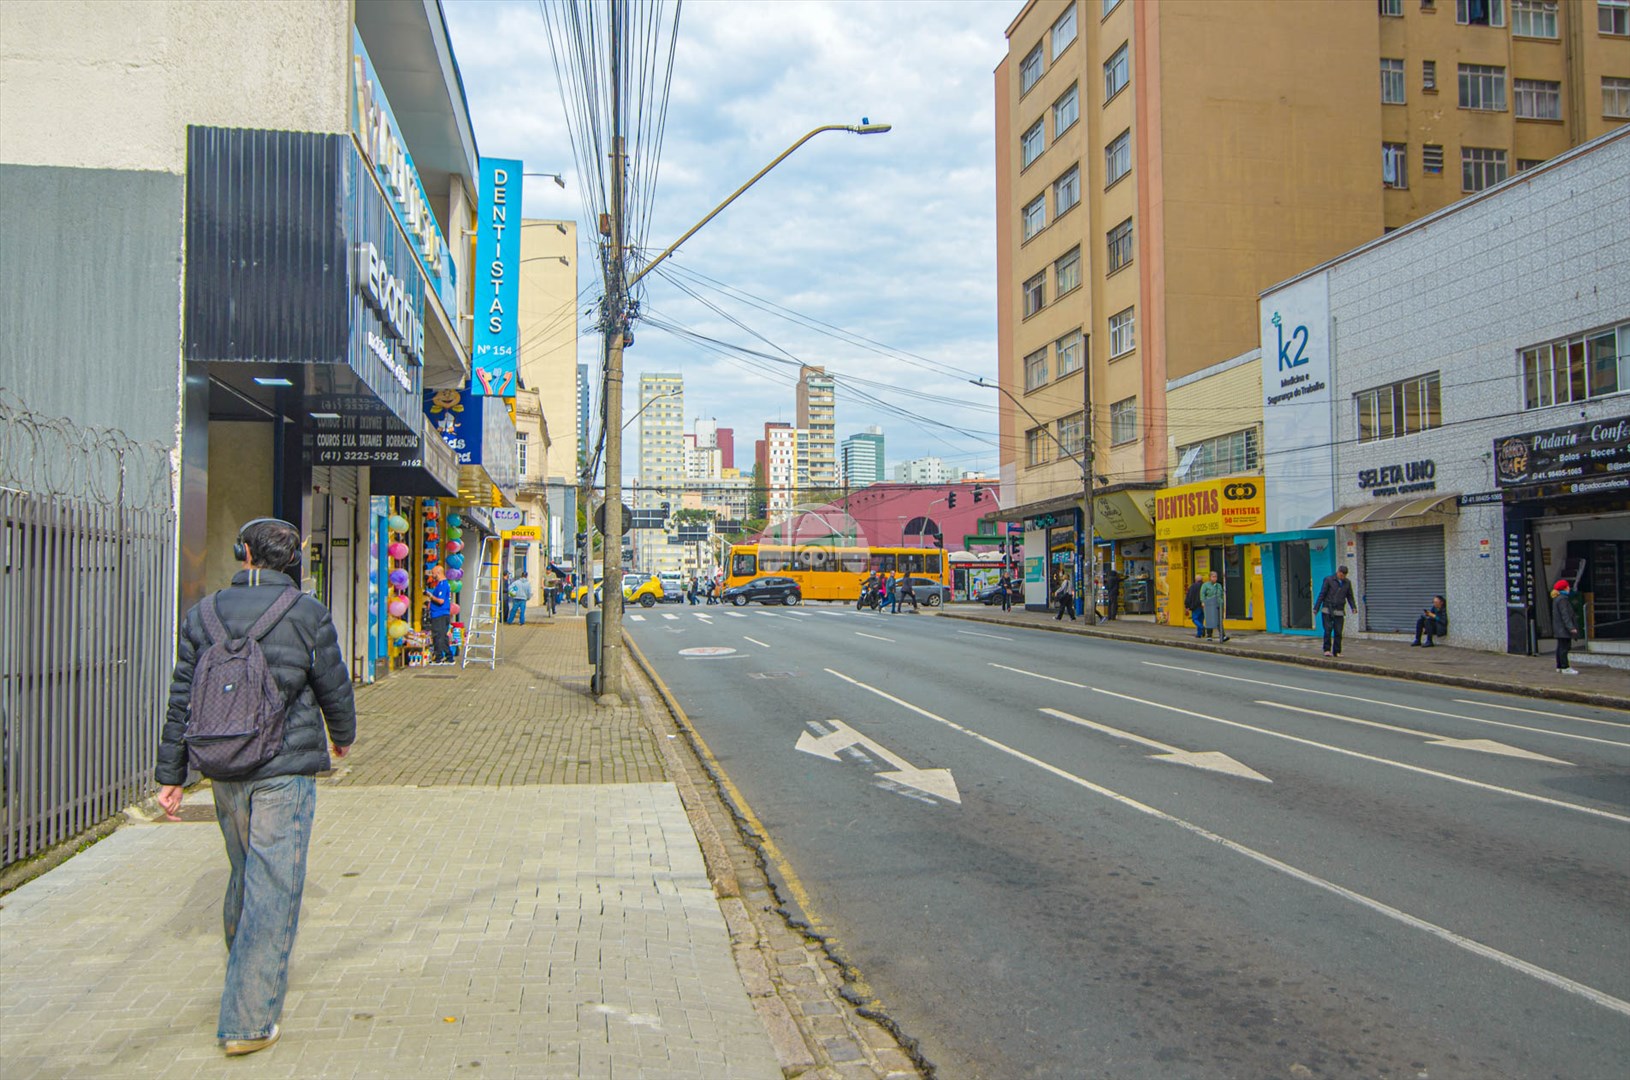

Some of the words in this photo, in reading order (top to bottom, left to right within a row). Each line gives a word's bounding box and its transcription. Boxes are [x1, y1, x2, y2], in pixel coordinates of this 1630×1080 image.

[489, 169, 508, 333] DENTISTAS
[493, 346, 512, 355] 154
[1278, 323, 1309, 372] k2
[1267, 391, 1293, 405] Segurança
[1294, 388, 1302, 397] do
[1301, 381, 1325, 395] Trabalho
[317, 434, 340, 446] COUROS
[360, 434, 382, 447] TATAMES
[386, 434, 418, 447] BORRACHAS
[1533, 430, 1578, 450] Padaria
[321, 451, 341, 461] (41)
[344, 451, 399, 461] 3225-5982
[1559, 453, 1580, 462] Bolos
[1590, 448, 1616, 457] Doces
[1358, 464, 1404, 489] SELETA
[1406, 459, 1436, 482] UNO
[1157, 488, 1219, 521] DENTISTAS
[1222, 507, 1260, 515] DENTISTAS
